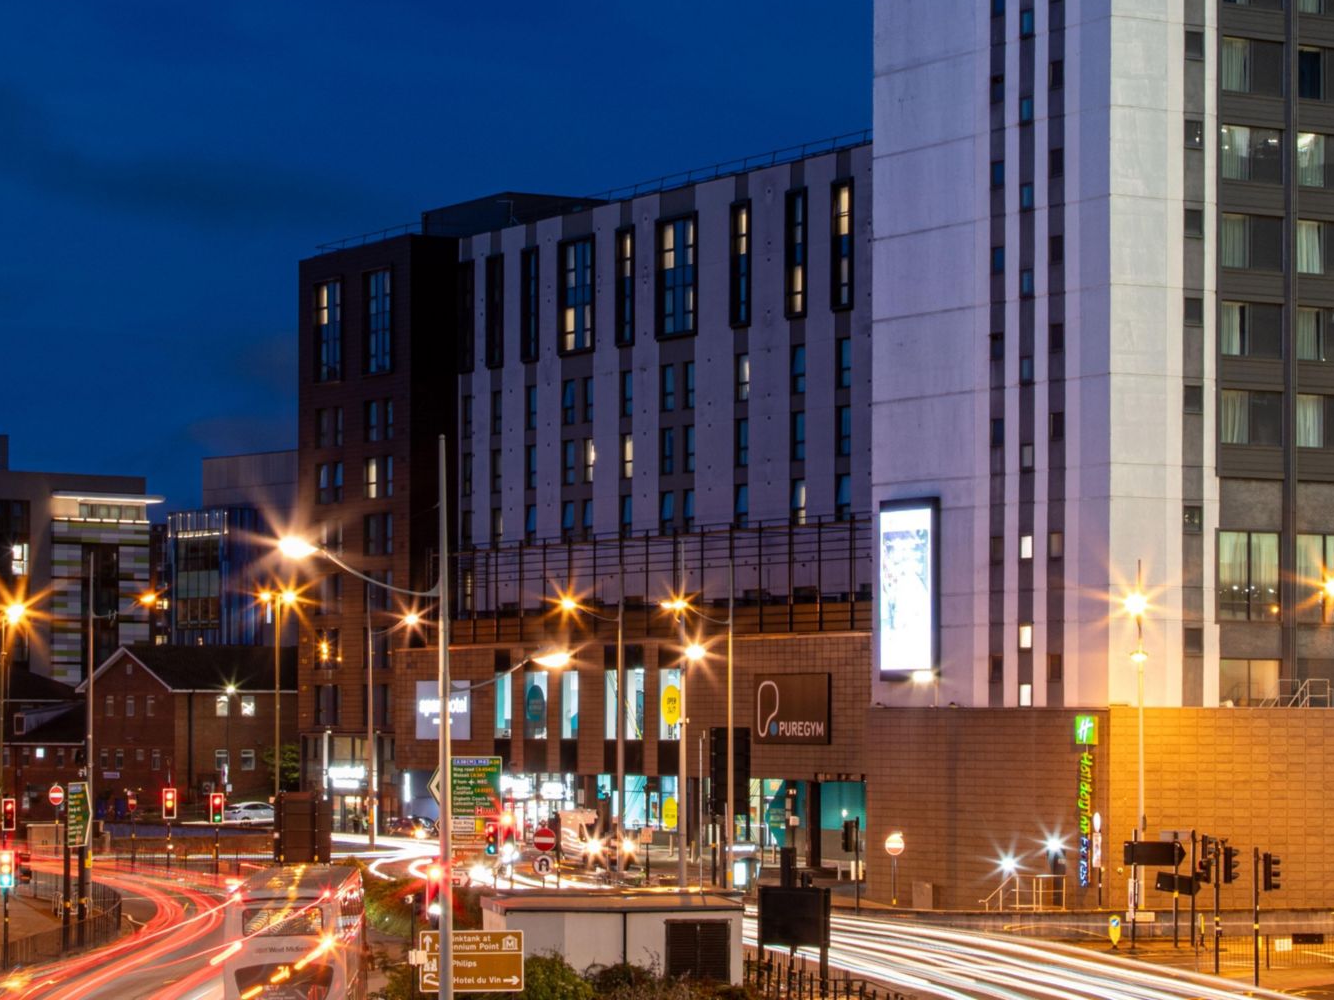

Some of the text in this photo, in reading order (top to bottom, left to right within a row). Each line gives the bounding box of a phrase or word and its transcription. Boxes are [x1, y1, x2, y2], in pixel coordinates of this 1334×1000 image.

[779, 721, 824, 737] PUREGYM
[1078, 752, 1093, 887] Holiday Inn Exress
[452, 960, 477, 968] Philips
